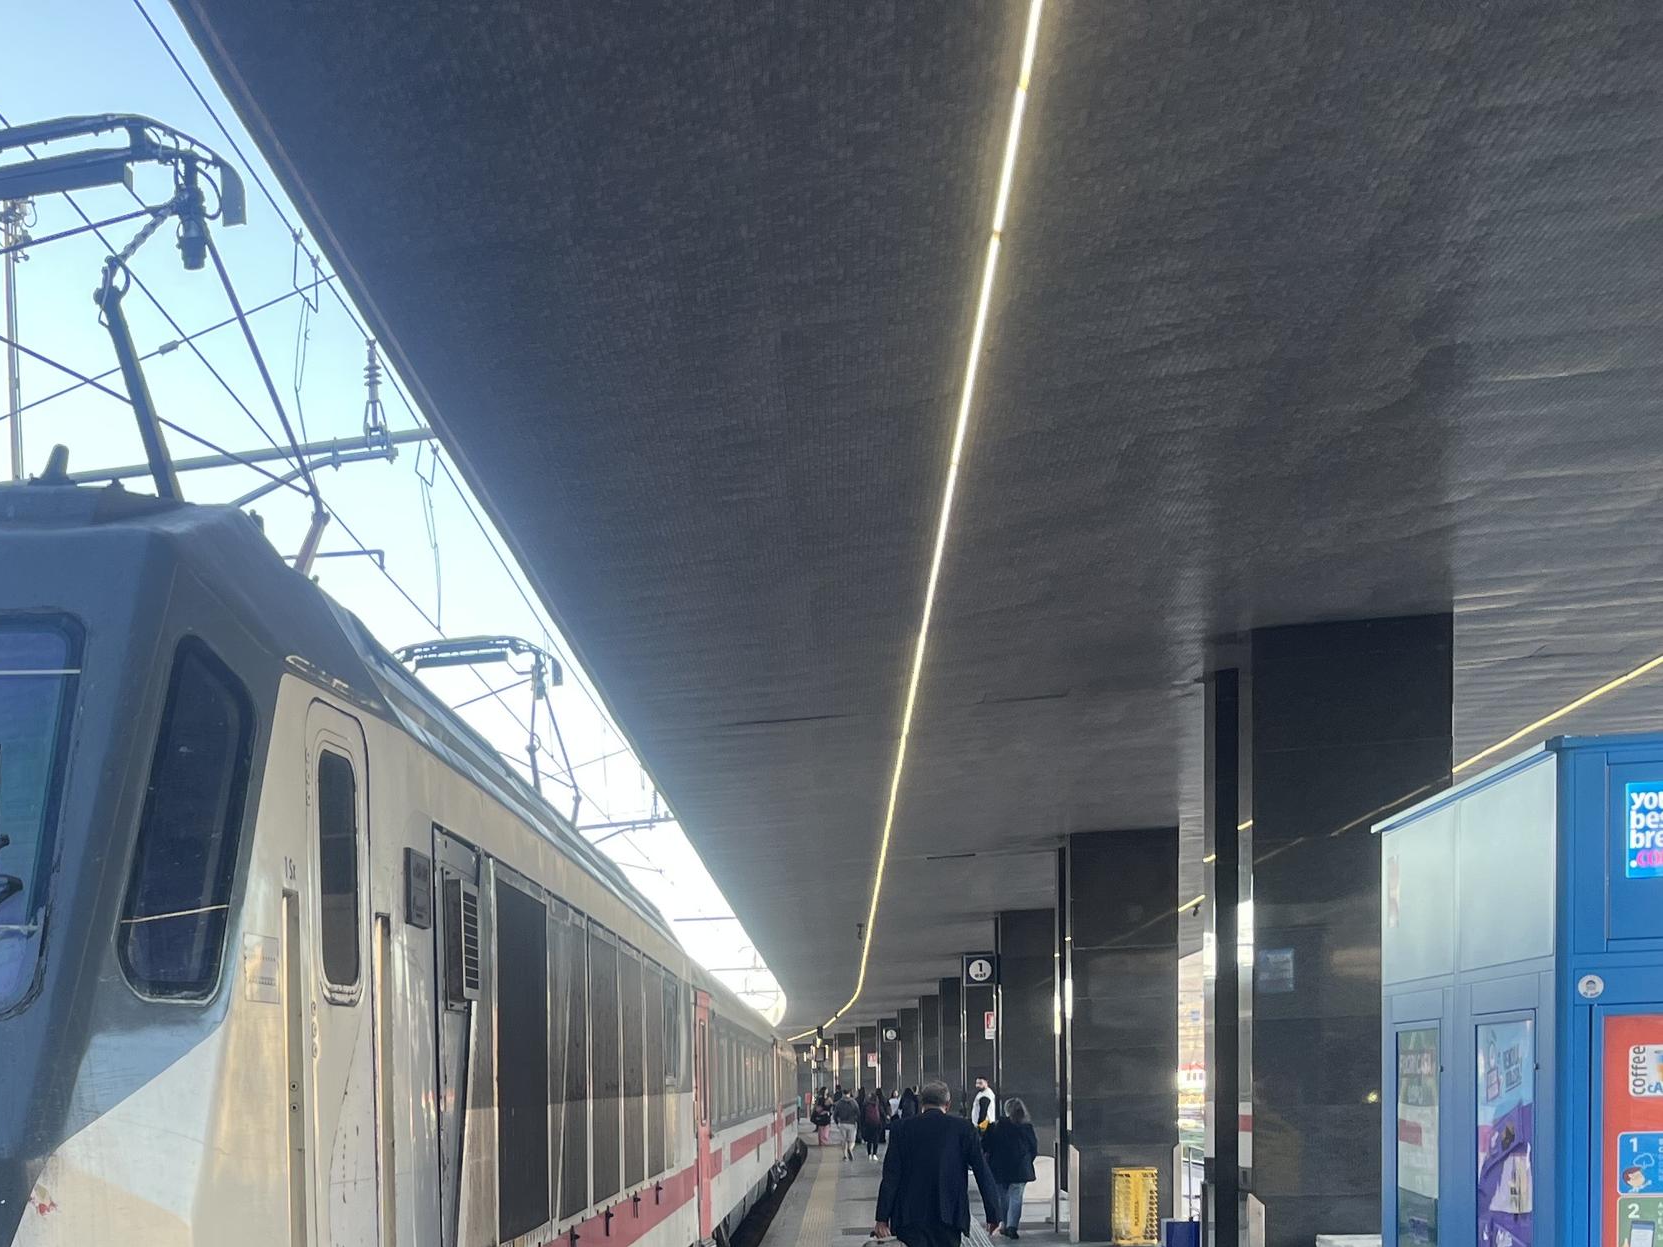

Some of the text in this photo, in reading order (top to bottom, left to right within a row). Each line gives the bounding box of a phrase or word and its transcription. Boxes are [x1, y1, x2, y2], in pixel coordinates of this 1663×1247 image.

[978, 962, 983, 972] 1
[1632, 1046, 1647, 1095] coffee
[1629, 1137, 1638, 1153] 1
[1628, 1203, 1640, 1219] 2
